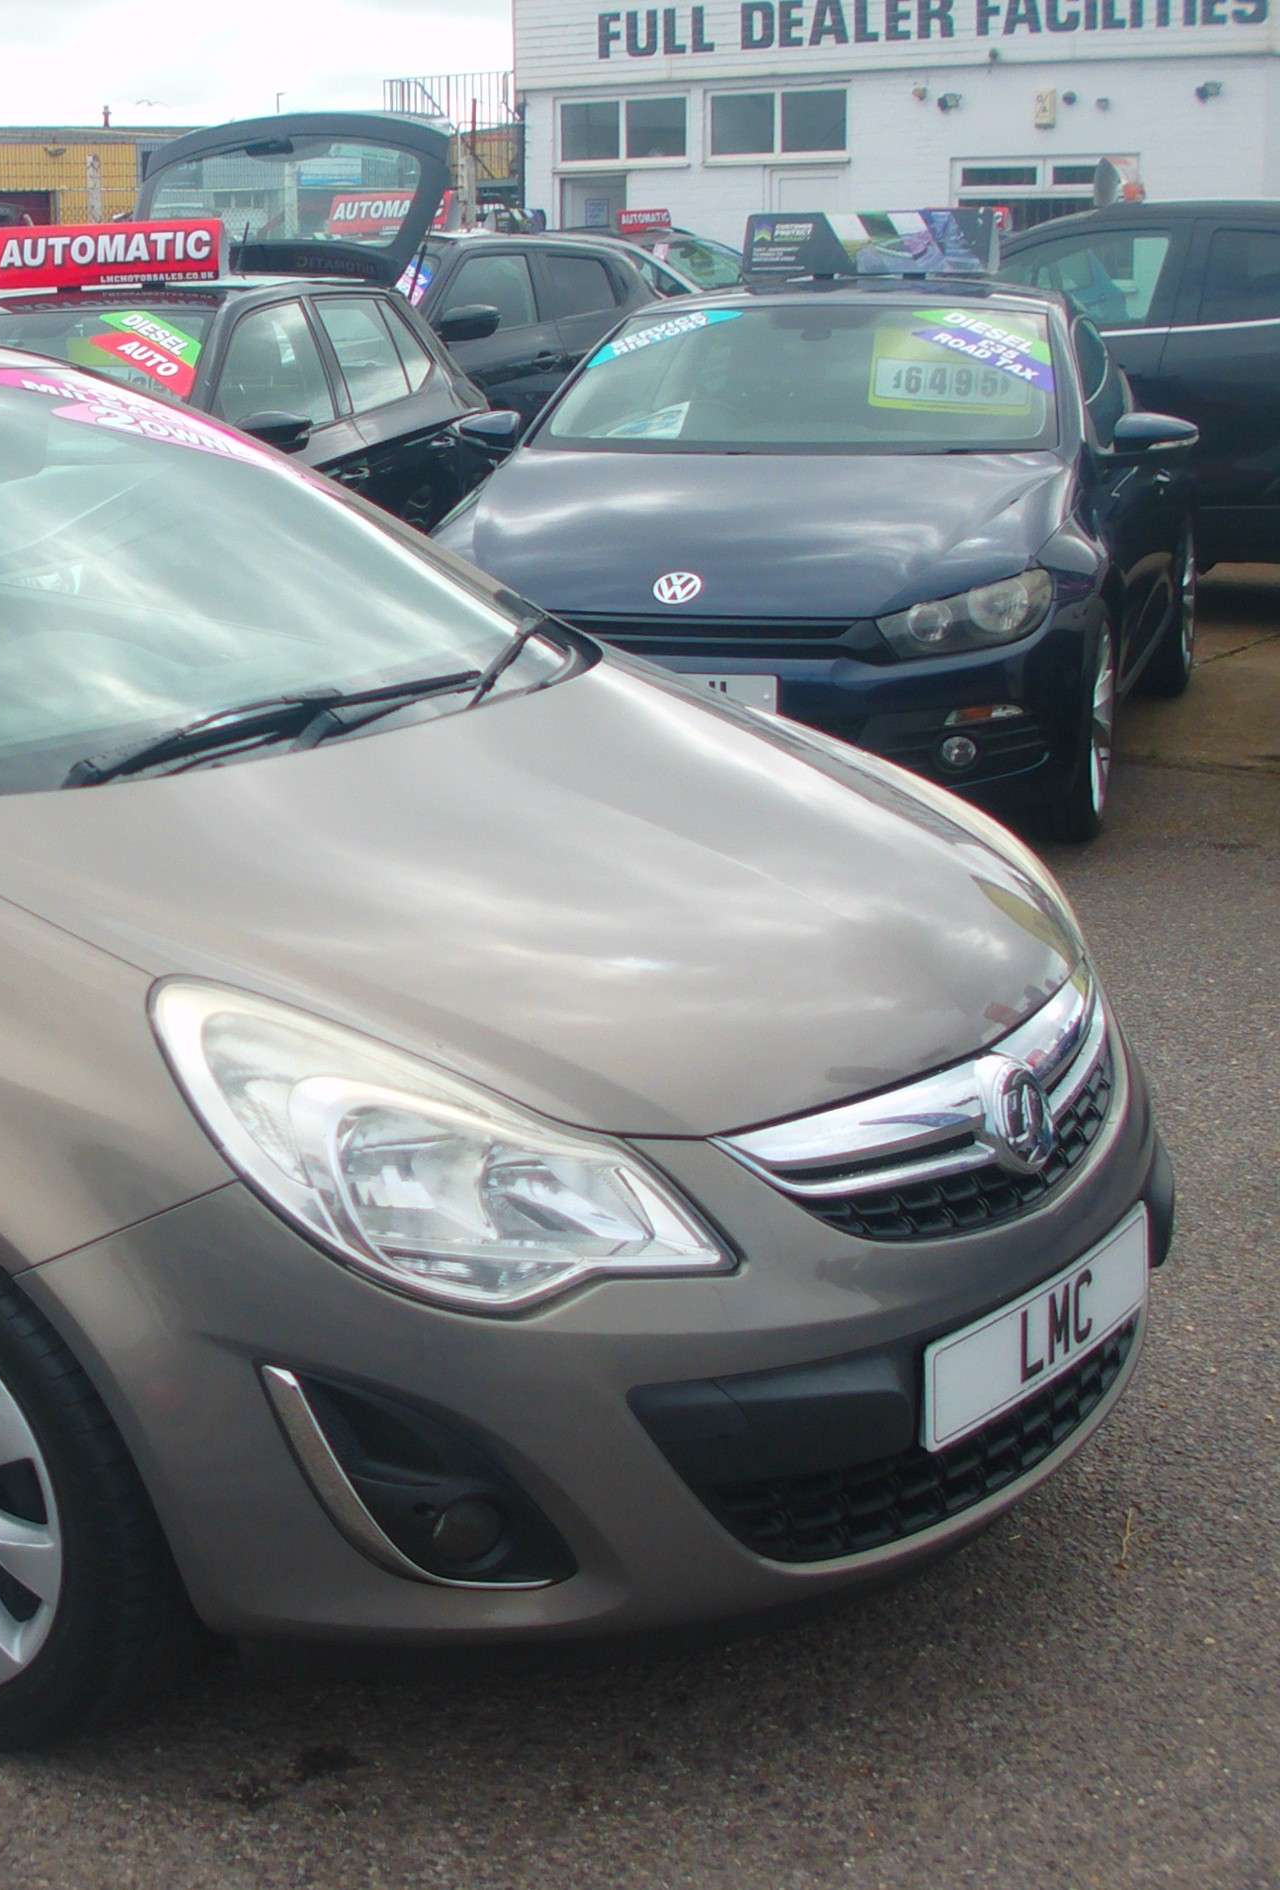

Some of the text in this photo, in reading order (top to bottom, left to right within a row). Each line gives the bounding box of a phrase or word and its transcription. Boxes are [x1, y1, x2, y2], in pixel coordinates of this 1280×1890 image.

[598, 6, 714, 60] FULL
[740, 0, 955, 51] DEALER
[0, 229, 211, 268] AUTOMATIC
[120, 314, 189, 358] DIESEL
[943, 312, 1034, 354] DIESEL
[978, 338, 1020, 360] £35
[116, 340, 180, 377] AUTO
[932, 331, 1041, 381] ROAD TAX
[1020, 1268, 1094, 1385] LMC
